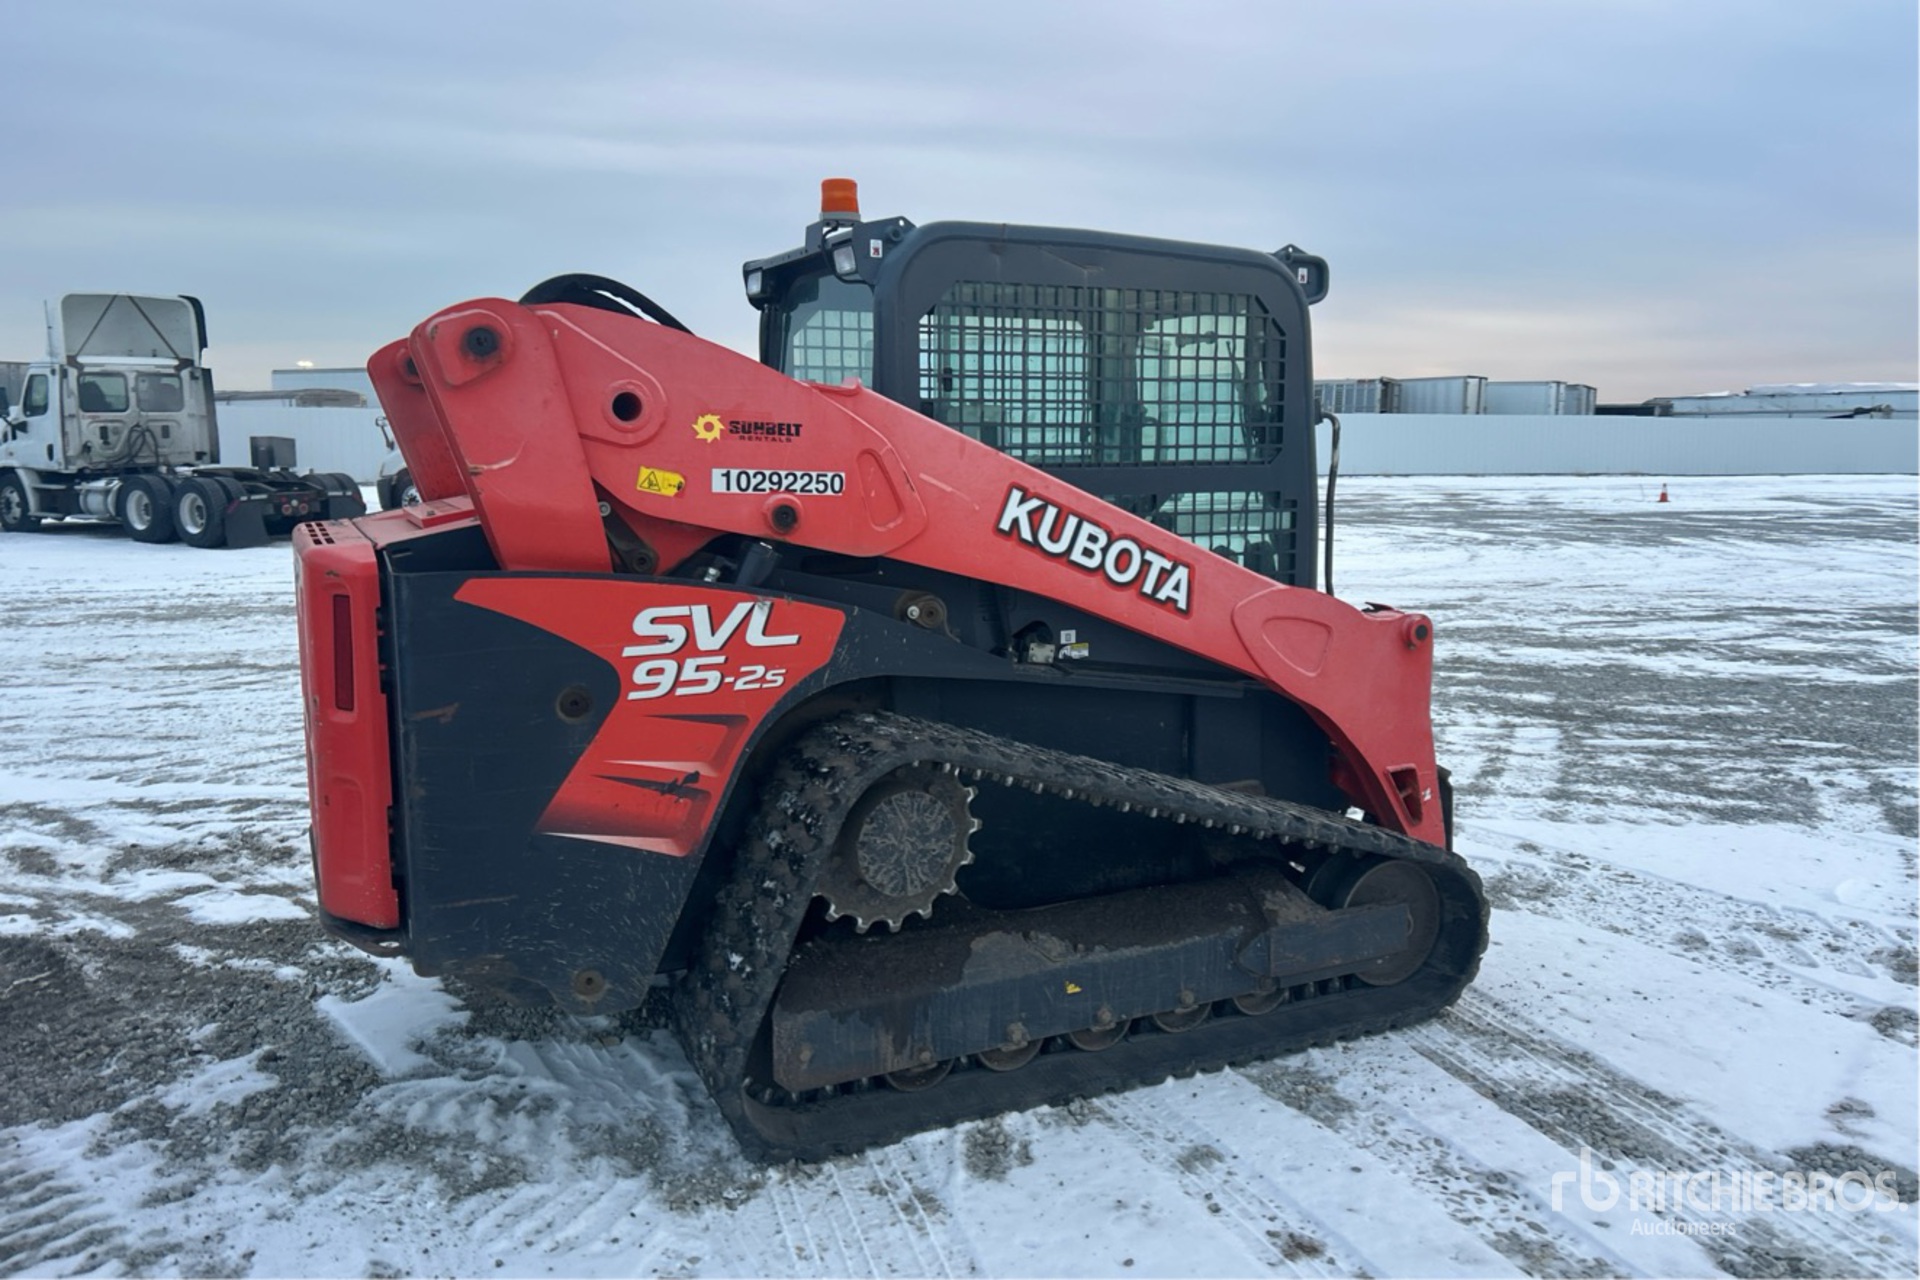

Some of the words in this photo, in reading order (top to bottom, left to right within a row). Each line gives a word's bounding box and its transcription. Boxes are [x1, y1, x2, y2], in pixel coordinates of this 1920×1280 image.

[729, 420, 802, 437] SUNBELT
[739, 435, 792, 443] RENTALS
[721, 470, 844, 494] 10292250
[998, 488, 1190, 612] KUBOTA
[622, 601, 800, 657] SVL
